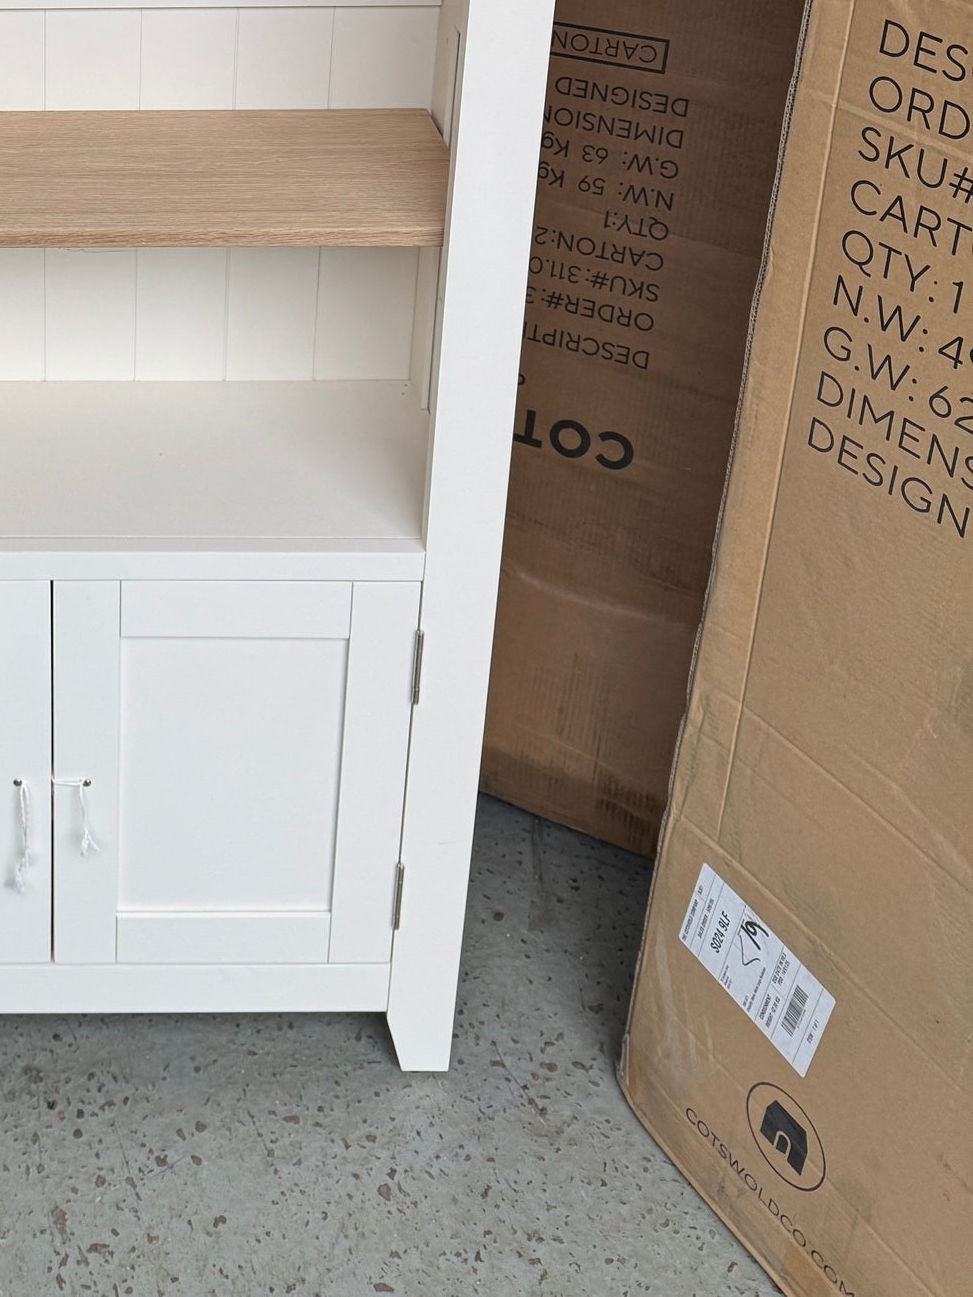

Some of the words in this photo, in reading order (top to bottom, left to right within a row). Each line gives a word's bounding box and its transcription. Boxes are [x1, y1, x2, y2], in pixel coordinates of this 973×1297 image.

[550, 30, 657, 63] CARTON
[554, 76, 690, 117] DESIGNED
[869, 76, 971, 140] ORD
[582, 144, 609, 164] 63
[578, 176, 606, 195] 59
[512, 409, 634, 470] COT
[808, 416, 971, 539] DESIGN
[710, 926, 725, 954] SO24
[718, 910, 732, 932] 9LF
